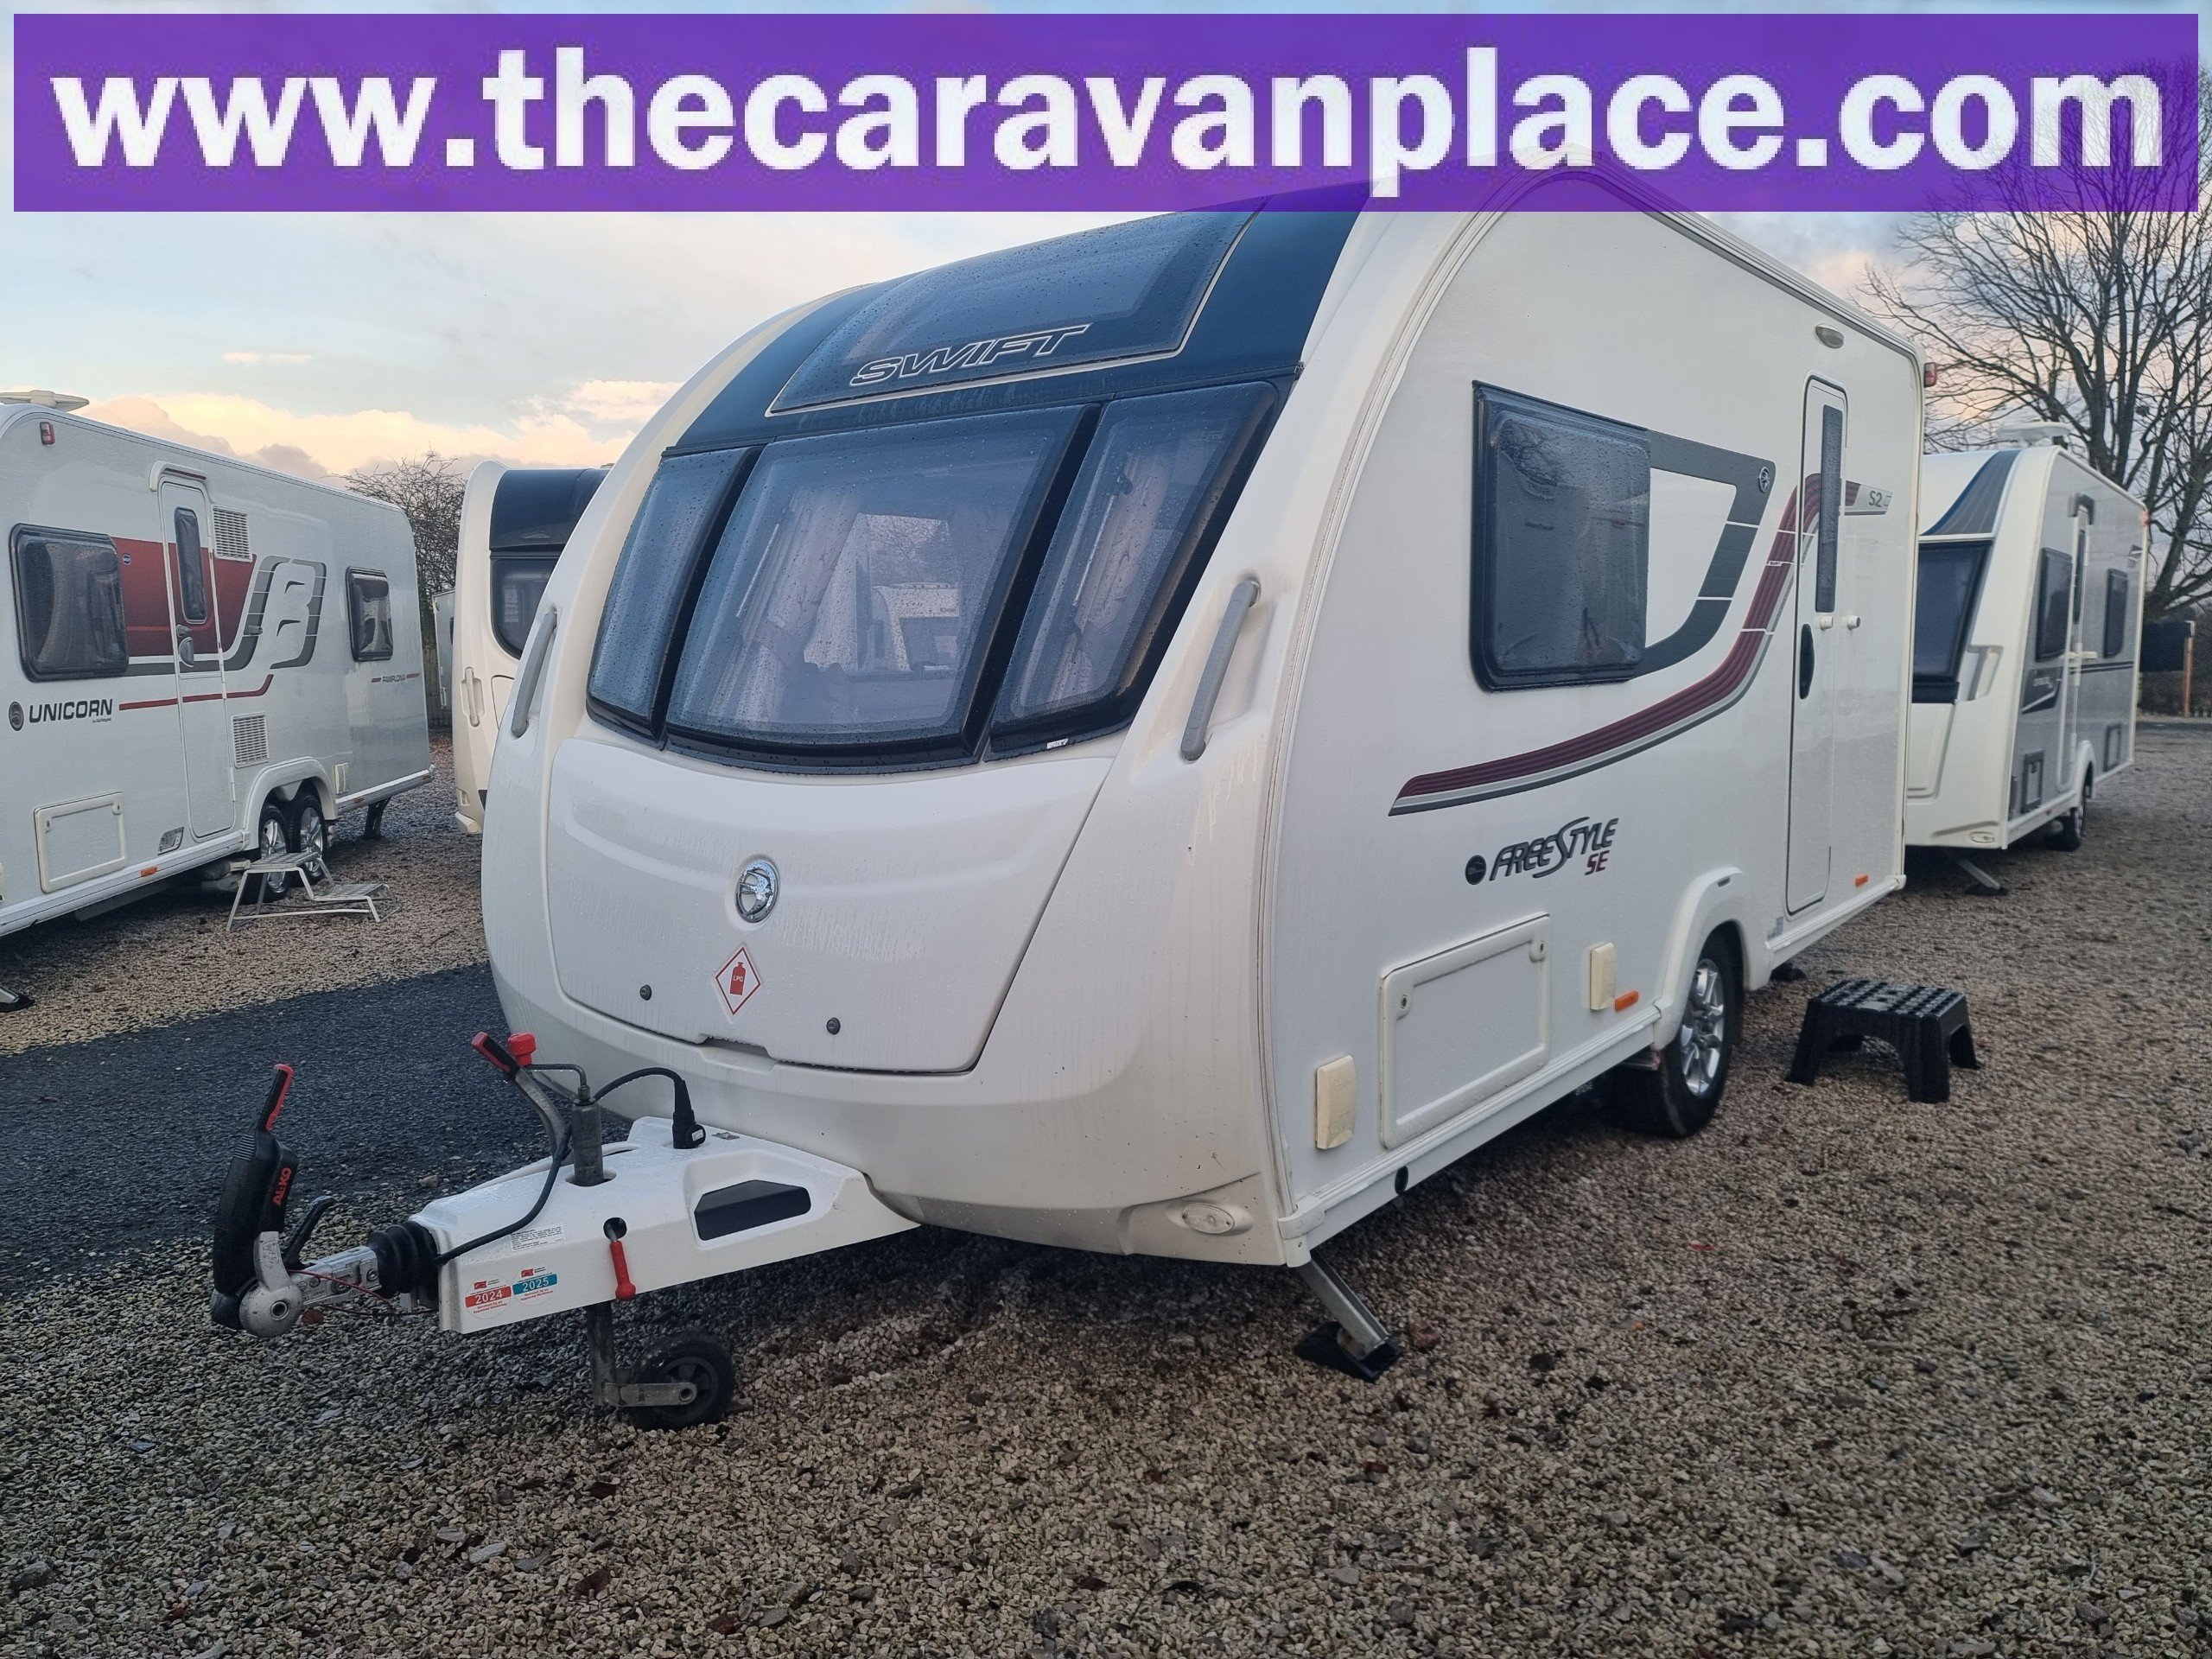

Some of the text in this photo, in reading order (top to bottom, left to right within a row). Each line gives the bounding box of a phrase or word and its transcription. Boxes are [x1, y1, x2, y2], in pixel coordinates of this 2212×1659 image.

[849, 322, 1093, 387] SWIFT
[29, 698, 113, 724] UNICORN
[1488, 816, 1619, 882] FREESTYLE
[1584, 849, 1611, 876] SE
[272, 1166, 292, 1206] AL-KO
[474, 1289, 503, 1305] 2024
[522, 1277, 550, 1292] 2025
